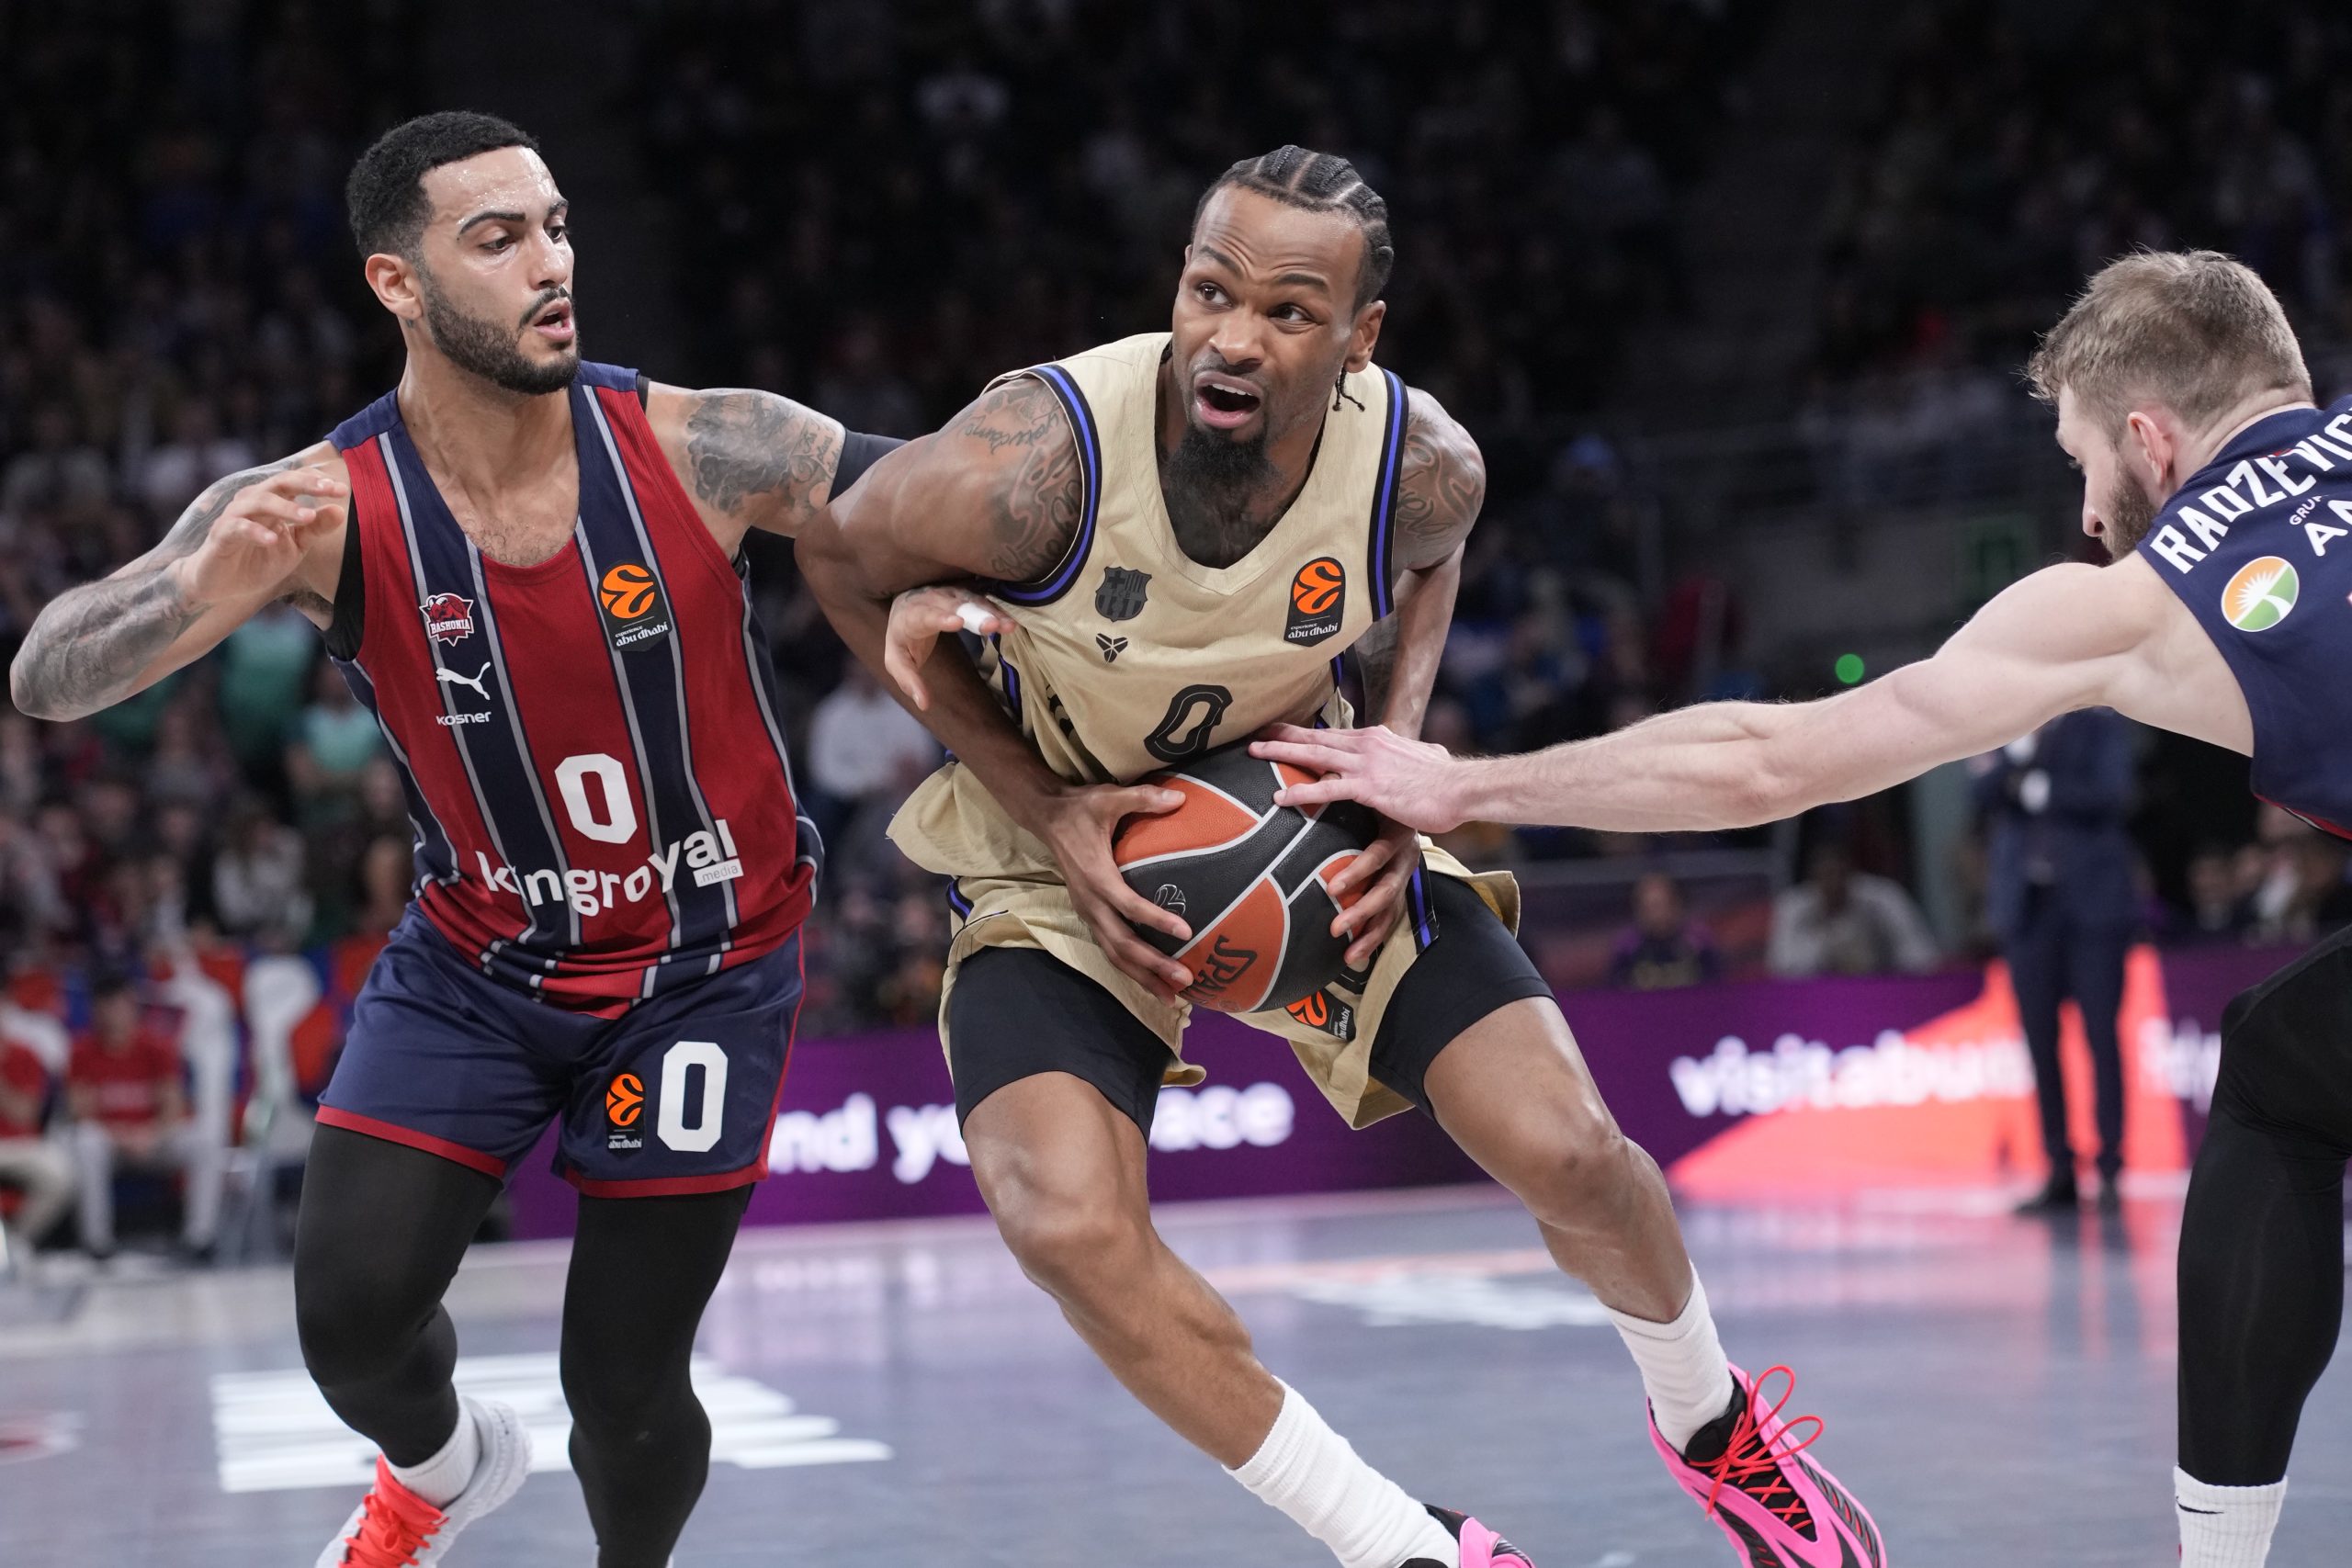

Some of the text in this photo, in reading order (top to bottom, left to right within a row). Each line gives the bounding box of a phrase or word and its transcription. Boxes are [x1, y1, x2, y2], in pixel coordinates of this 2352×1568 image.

[2149, 407, 2352, 574] RADZEVIC
[616, 621, 669, 647] abu dhabi
[1288, 622, 1339, 639] abu dhabi
[435, 711, 492, 726] kosner
[555, 752, 638, 844] 0
[475, 818, 738, 917] kngroyal
[657, 1041, 729, 1153] 0
